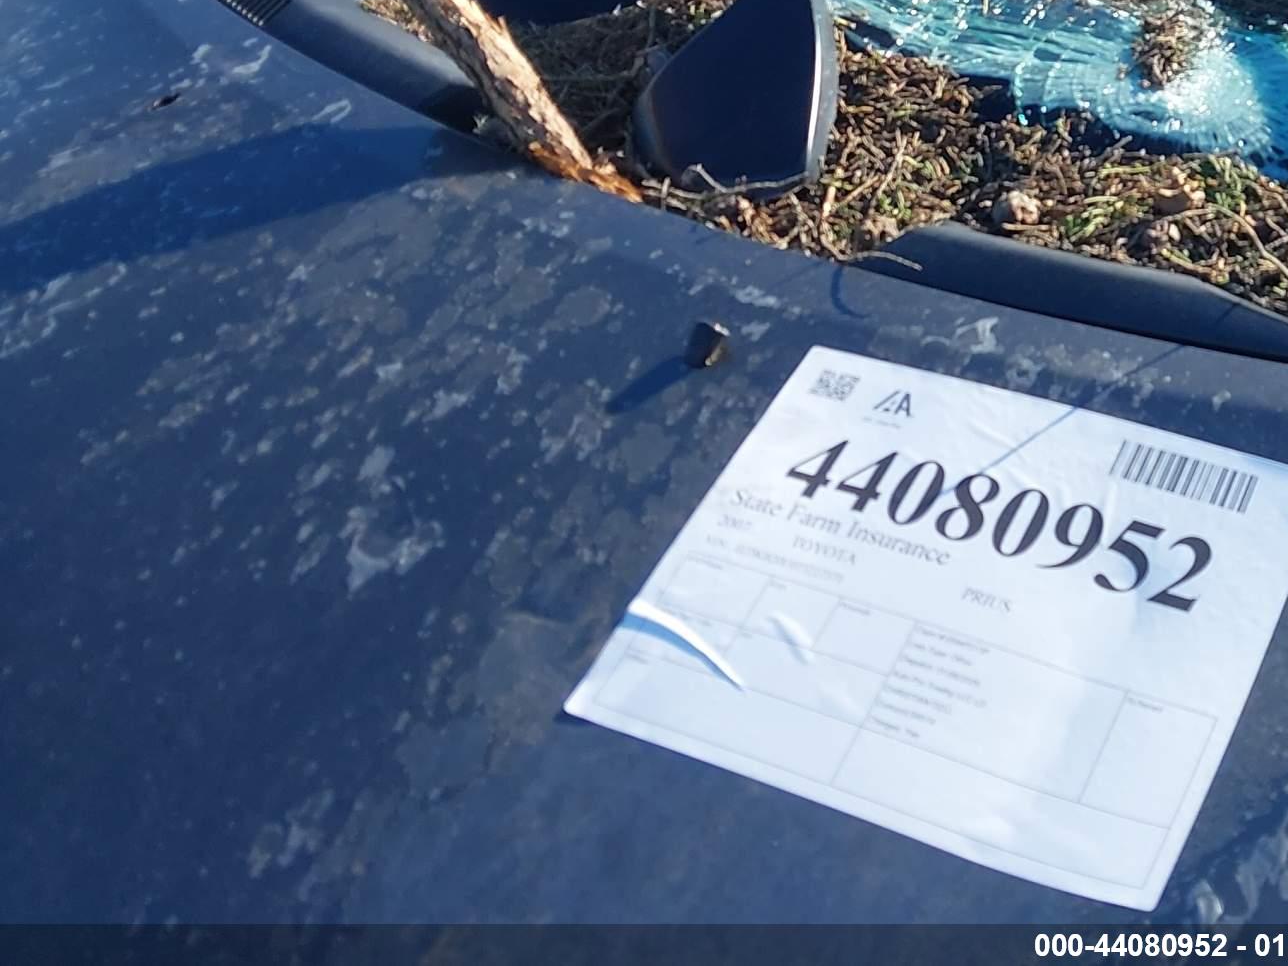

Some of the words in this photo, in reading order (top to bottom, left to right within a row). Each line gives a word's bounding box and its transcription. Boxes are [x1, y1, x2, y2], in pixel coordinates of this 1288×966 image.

[729, 489, 783, 517] State
[787, 501, 842, 533] Farm
[846, 520, 952, 566] Insurance
[786, 439, 1213, 612] 44080952
[792, 536, 857, 565] TOYOTA
[960, 587, 1013, 613] PRIUS
